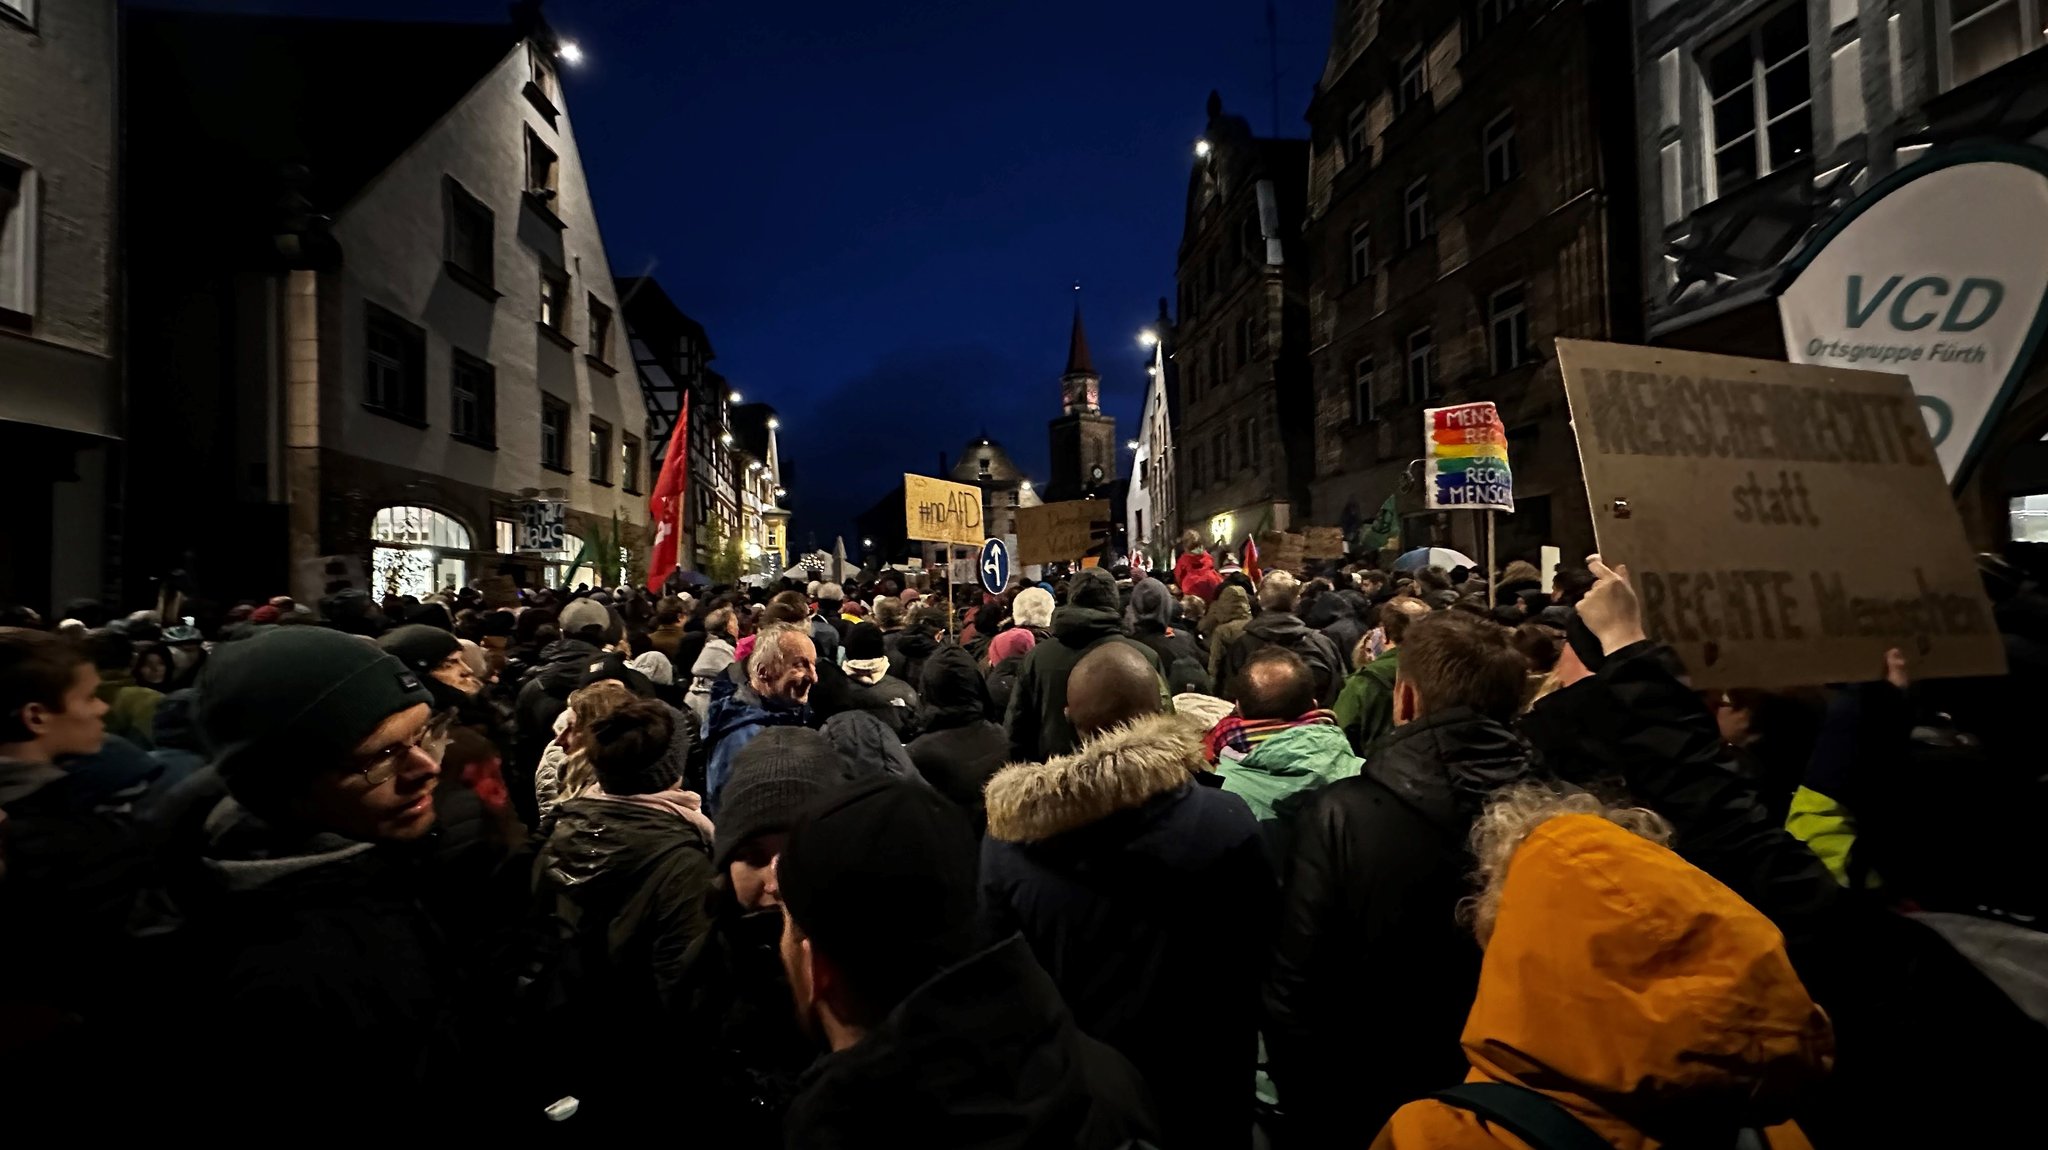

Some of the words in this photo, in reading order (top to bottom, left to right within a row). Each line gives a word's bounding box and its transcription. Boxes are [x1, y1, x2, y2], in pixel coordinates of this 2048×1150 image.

[1845, 275, 2005, 332] VCD
[1806, 339, 1923, 363] Ortsgruppe
[1927, 341, 1986, 363] Fürth
[1446, 407, 1499, 427] MENS
[1465, 427, 1498, 444] REC
[919, 490, 981, 528] #noAfD
[1449, 484, 1505, 504] MENSC
[1731, 468, 1821, 528] statt
[1638, 570, 1803, 643] RECHTE
